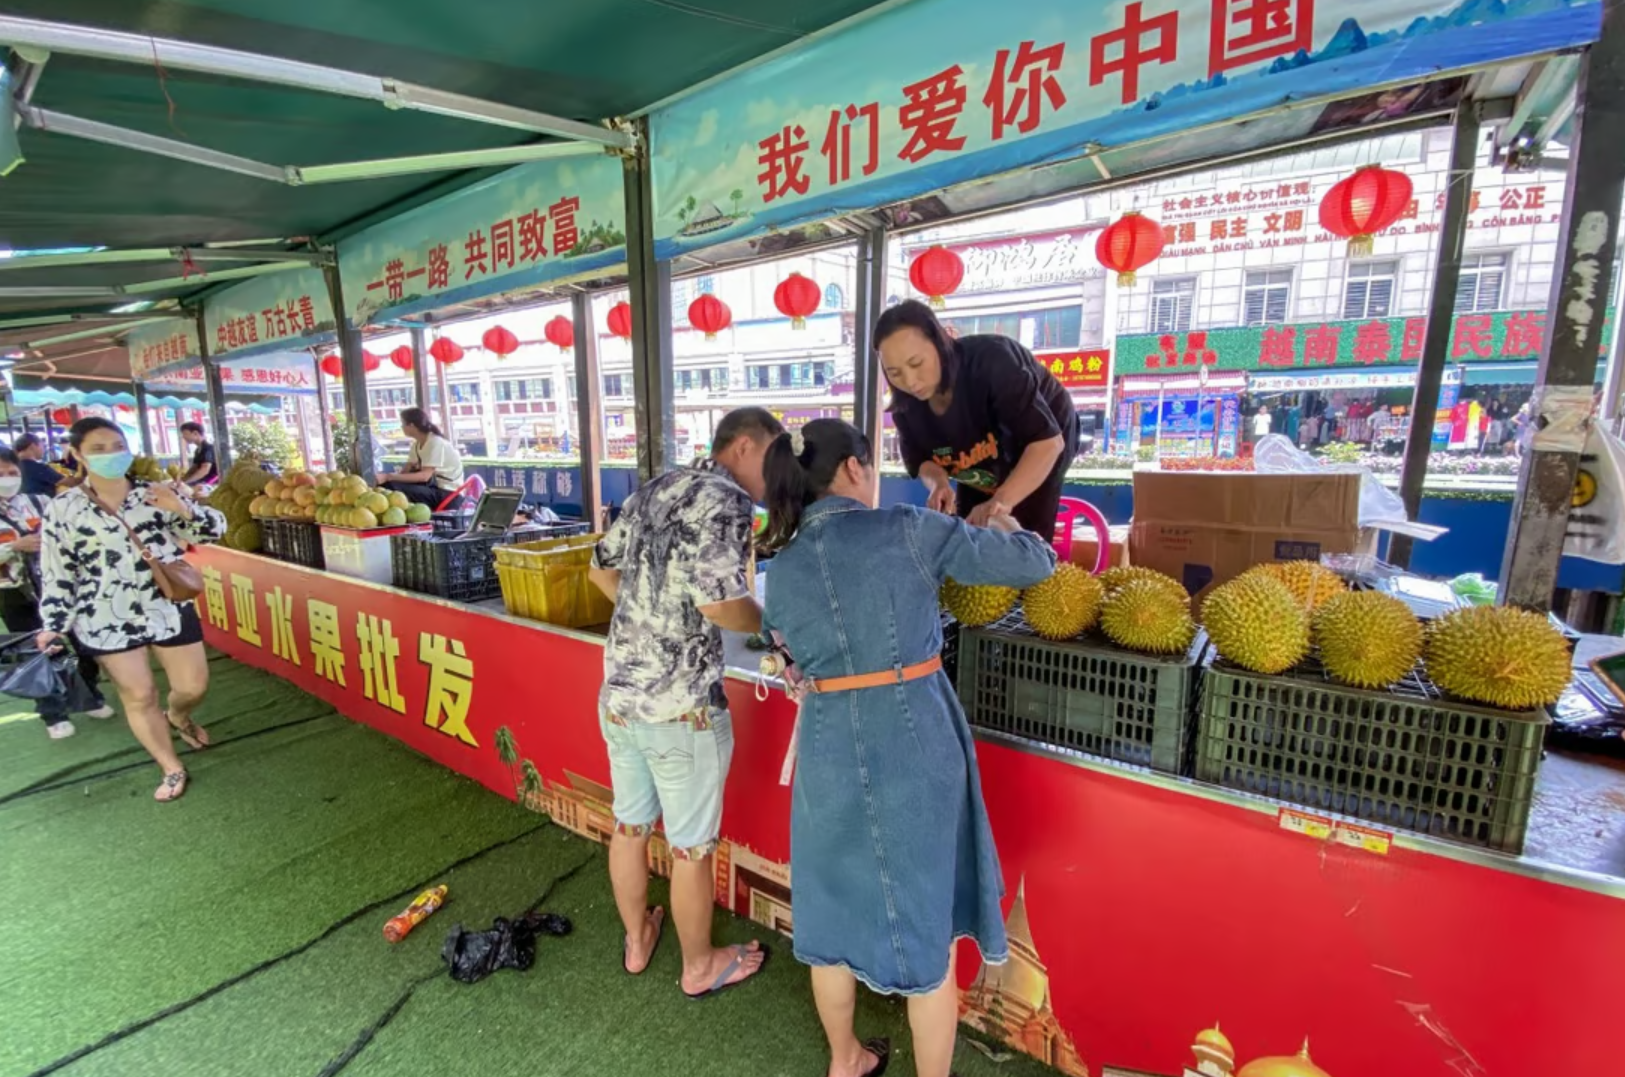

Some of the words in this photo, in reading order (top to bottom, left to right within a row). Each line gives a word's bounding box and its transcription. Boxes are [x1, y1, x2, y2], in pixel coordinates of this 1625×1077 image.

[757, 0, 1314, 203] 我们爱你中国
[1209, 216, 1248, 241] 民主
[1262, 209, 1304, 235] 文明
[1499, 186, 1546, 210] 公正
[366, 242, 450, 300] 一带一路
[464, 196, 580, 281] 共同致富
[217, 312, 259, 349] 中越友谊
[261, 294, 315, 339] 万古长青
[1257, 311, 1609, 367] 越南泰国民族
[241, 367, 309, 385] 感恩好心人
[1041, 355, 1103, 375] 南鸡粉
[195, 565, 480, 748] 南亚水果批发
